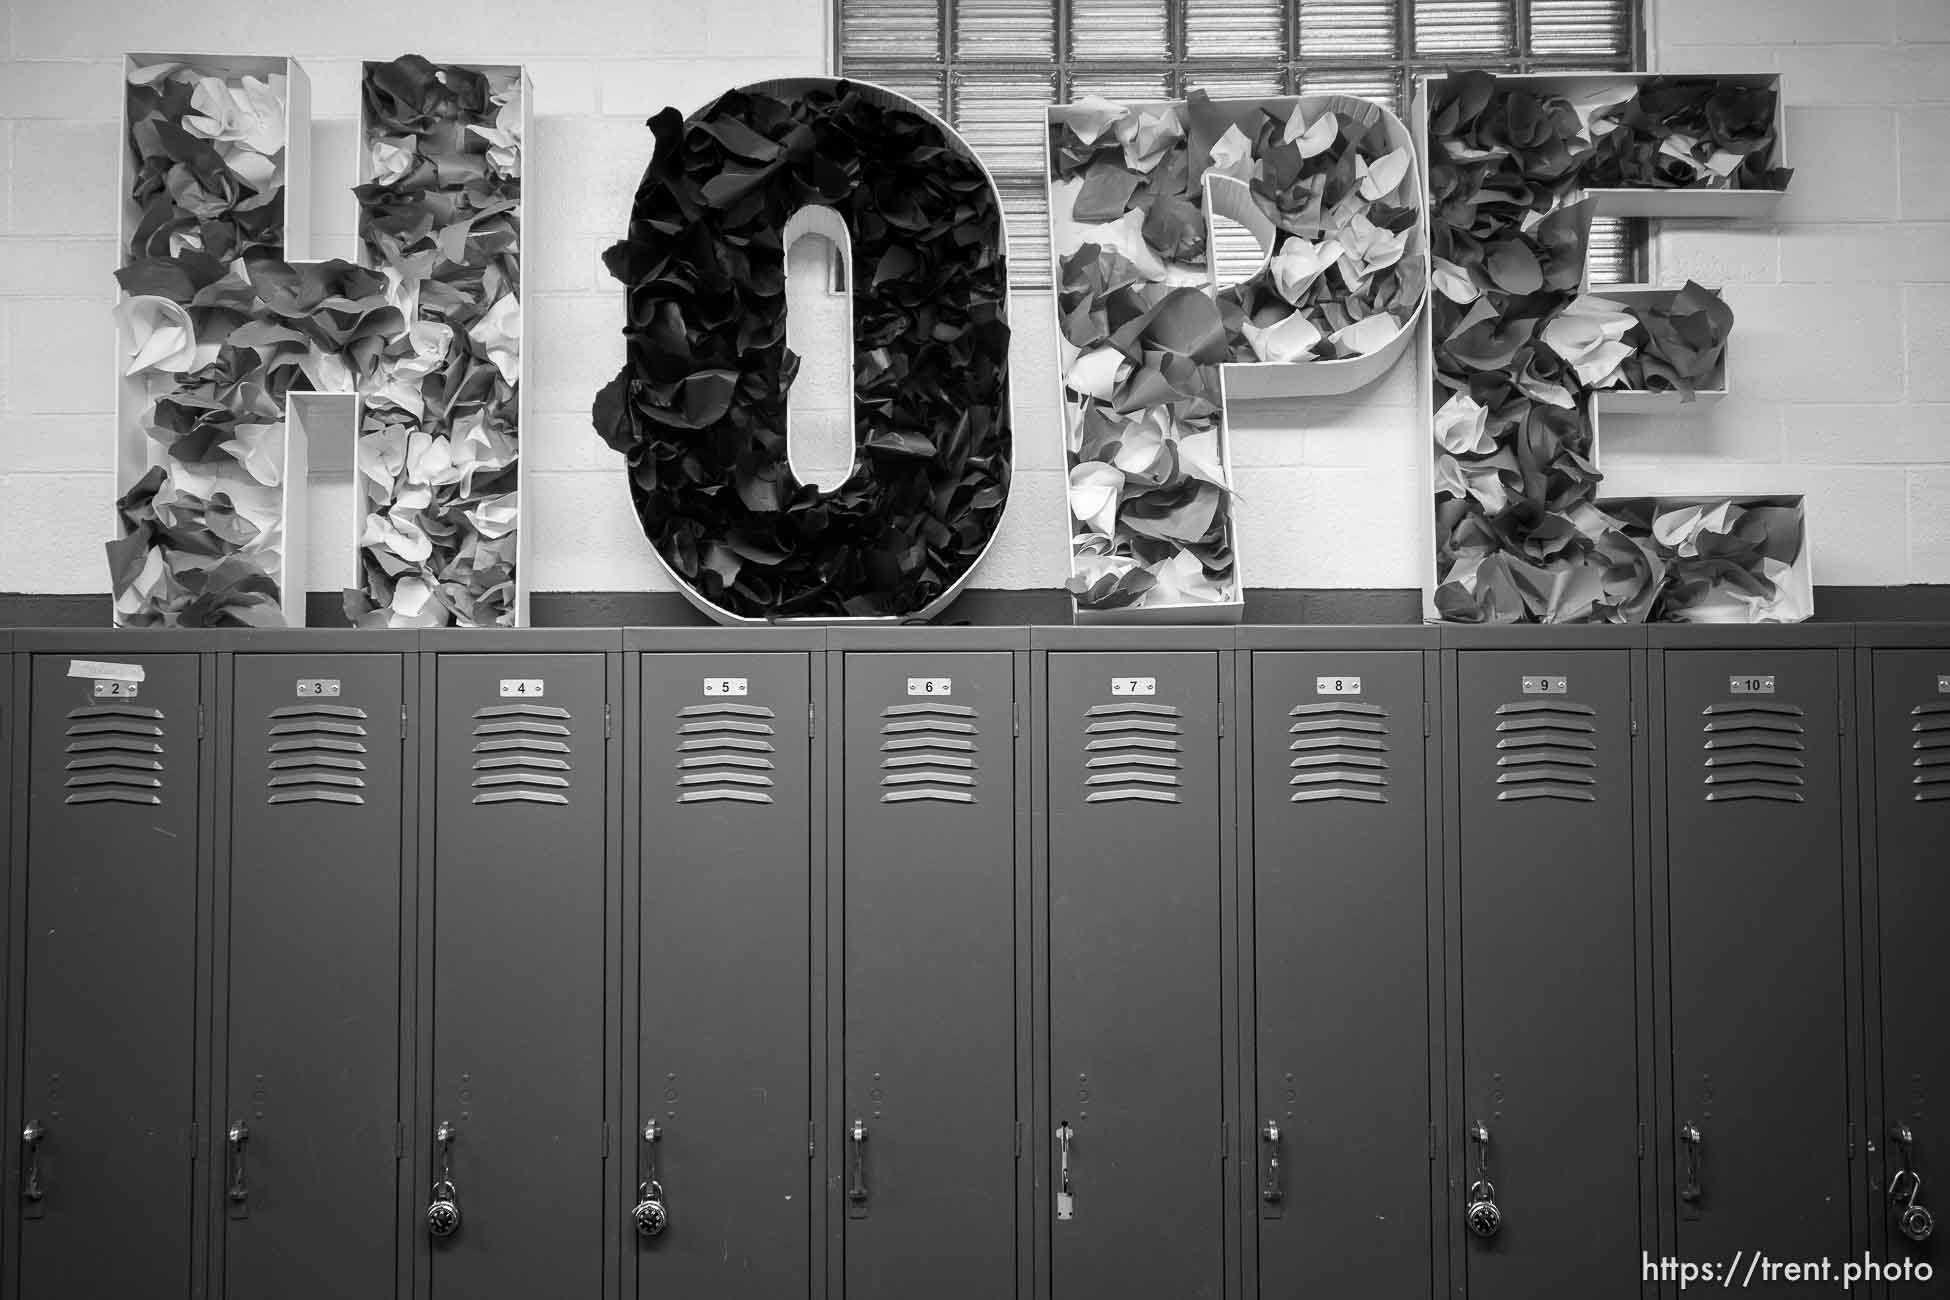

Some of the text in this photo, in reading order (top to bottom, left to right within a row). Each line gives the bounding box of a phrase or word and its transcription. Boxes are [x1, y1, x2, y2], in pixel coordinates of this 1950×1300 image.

[108, 51, 1814, 627] HOPE
[111, 683, 120, 695] 2
[314, 682, 322, 694] 3
[517, 682, 526, 694] 4
[721, 681, 730, 693] 5
[925, 681, 933, 693] 6
[1129, 681, 1138, 692] 7
[1335, 680, 1343, 691] 8
[1540, 679, 1549, 691] 9
[1745, 679, 1761, 691] 10
